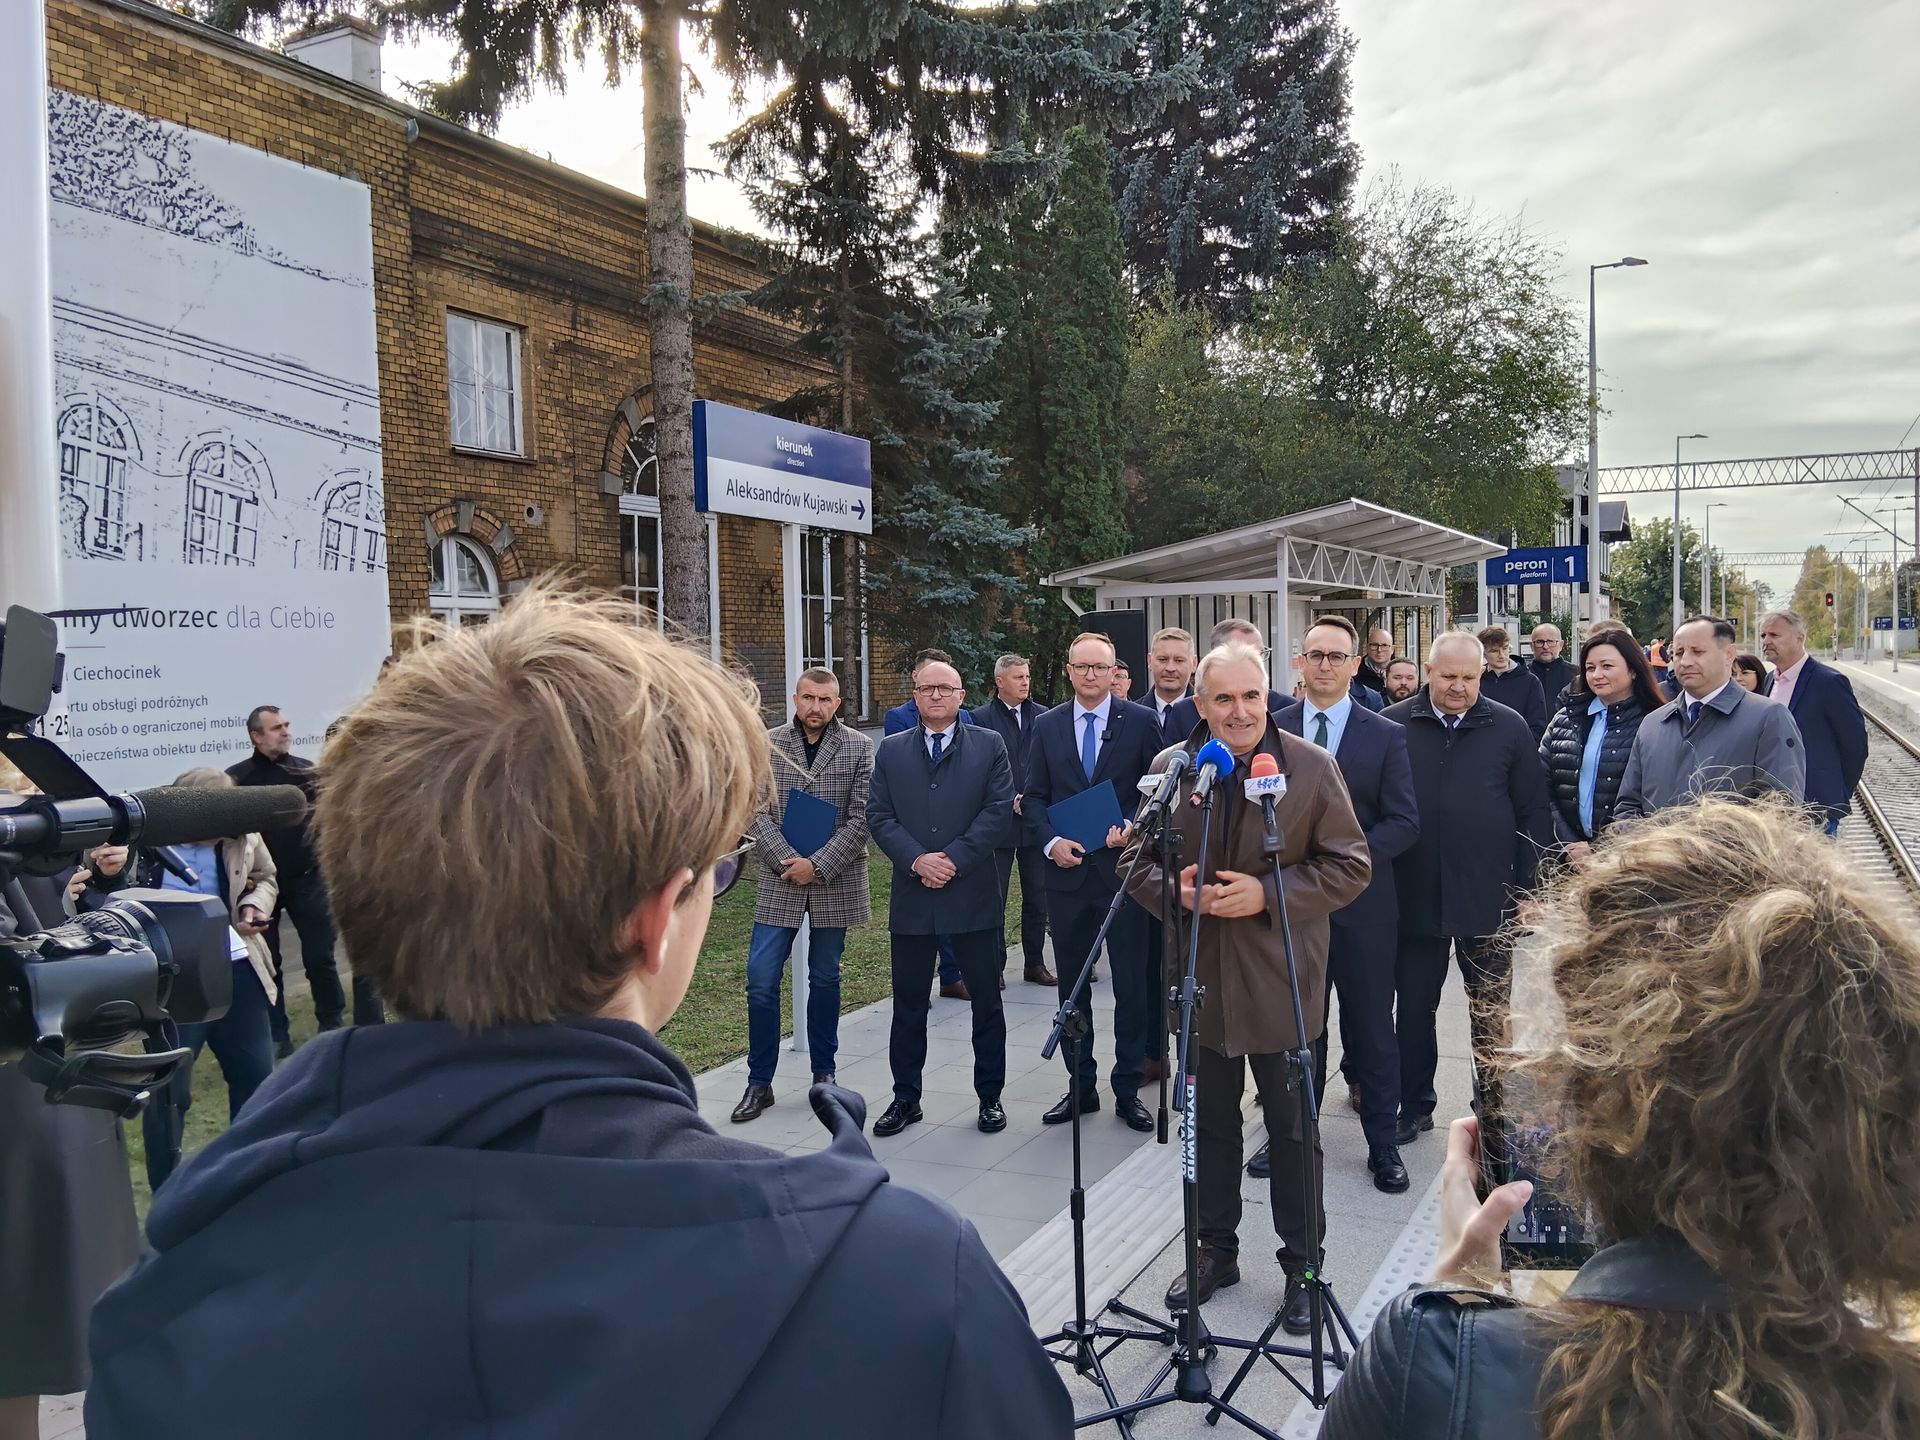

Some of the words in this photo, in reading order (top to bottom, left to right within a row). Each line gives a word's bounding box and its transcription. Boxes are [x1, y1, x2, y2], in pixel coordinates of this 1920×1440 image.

[776, 436, 813, 457] kierunek
[786, 457, 805, 467] direction
[726, 478, 801, 507] Aleksandrów
[803, 492, 848, 515] Kujawski
[1505, 560, 1547, 573] peron
[1564, 556, 1575, 577] 1
[1520, 571, 1547, 579] platform
[112, 603, 218, 629] dworzec
[227, 604, 261, 628] dla
[270, 605, 334, 628] Ciebie
[73, 665, 161, 681] Ciechocinek
[67, 701, 88, 712] rtu
[92, 697, 137, 713] obsługi
[141, 695, 208, 713] podróżnych
[69, 725, 83, 737] la
[87, 721, 118, 736] osób
[121, 724, 129, 734] o
[132, 717, 207, 736] ograniczonej
[210, 716, 248, 729] mobiln
[152, 744, 197, 757] obiektu
[200, 739, 232, 755] dzięki
[1186, 1085, 1195, 1180] DYNAWID
